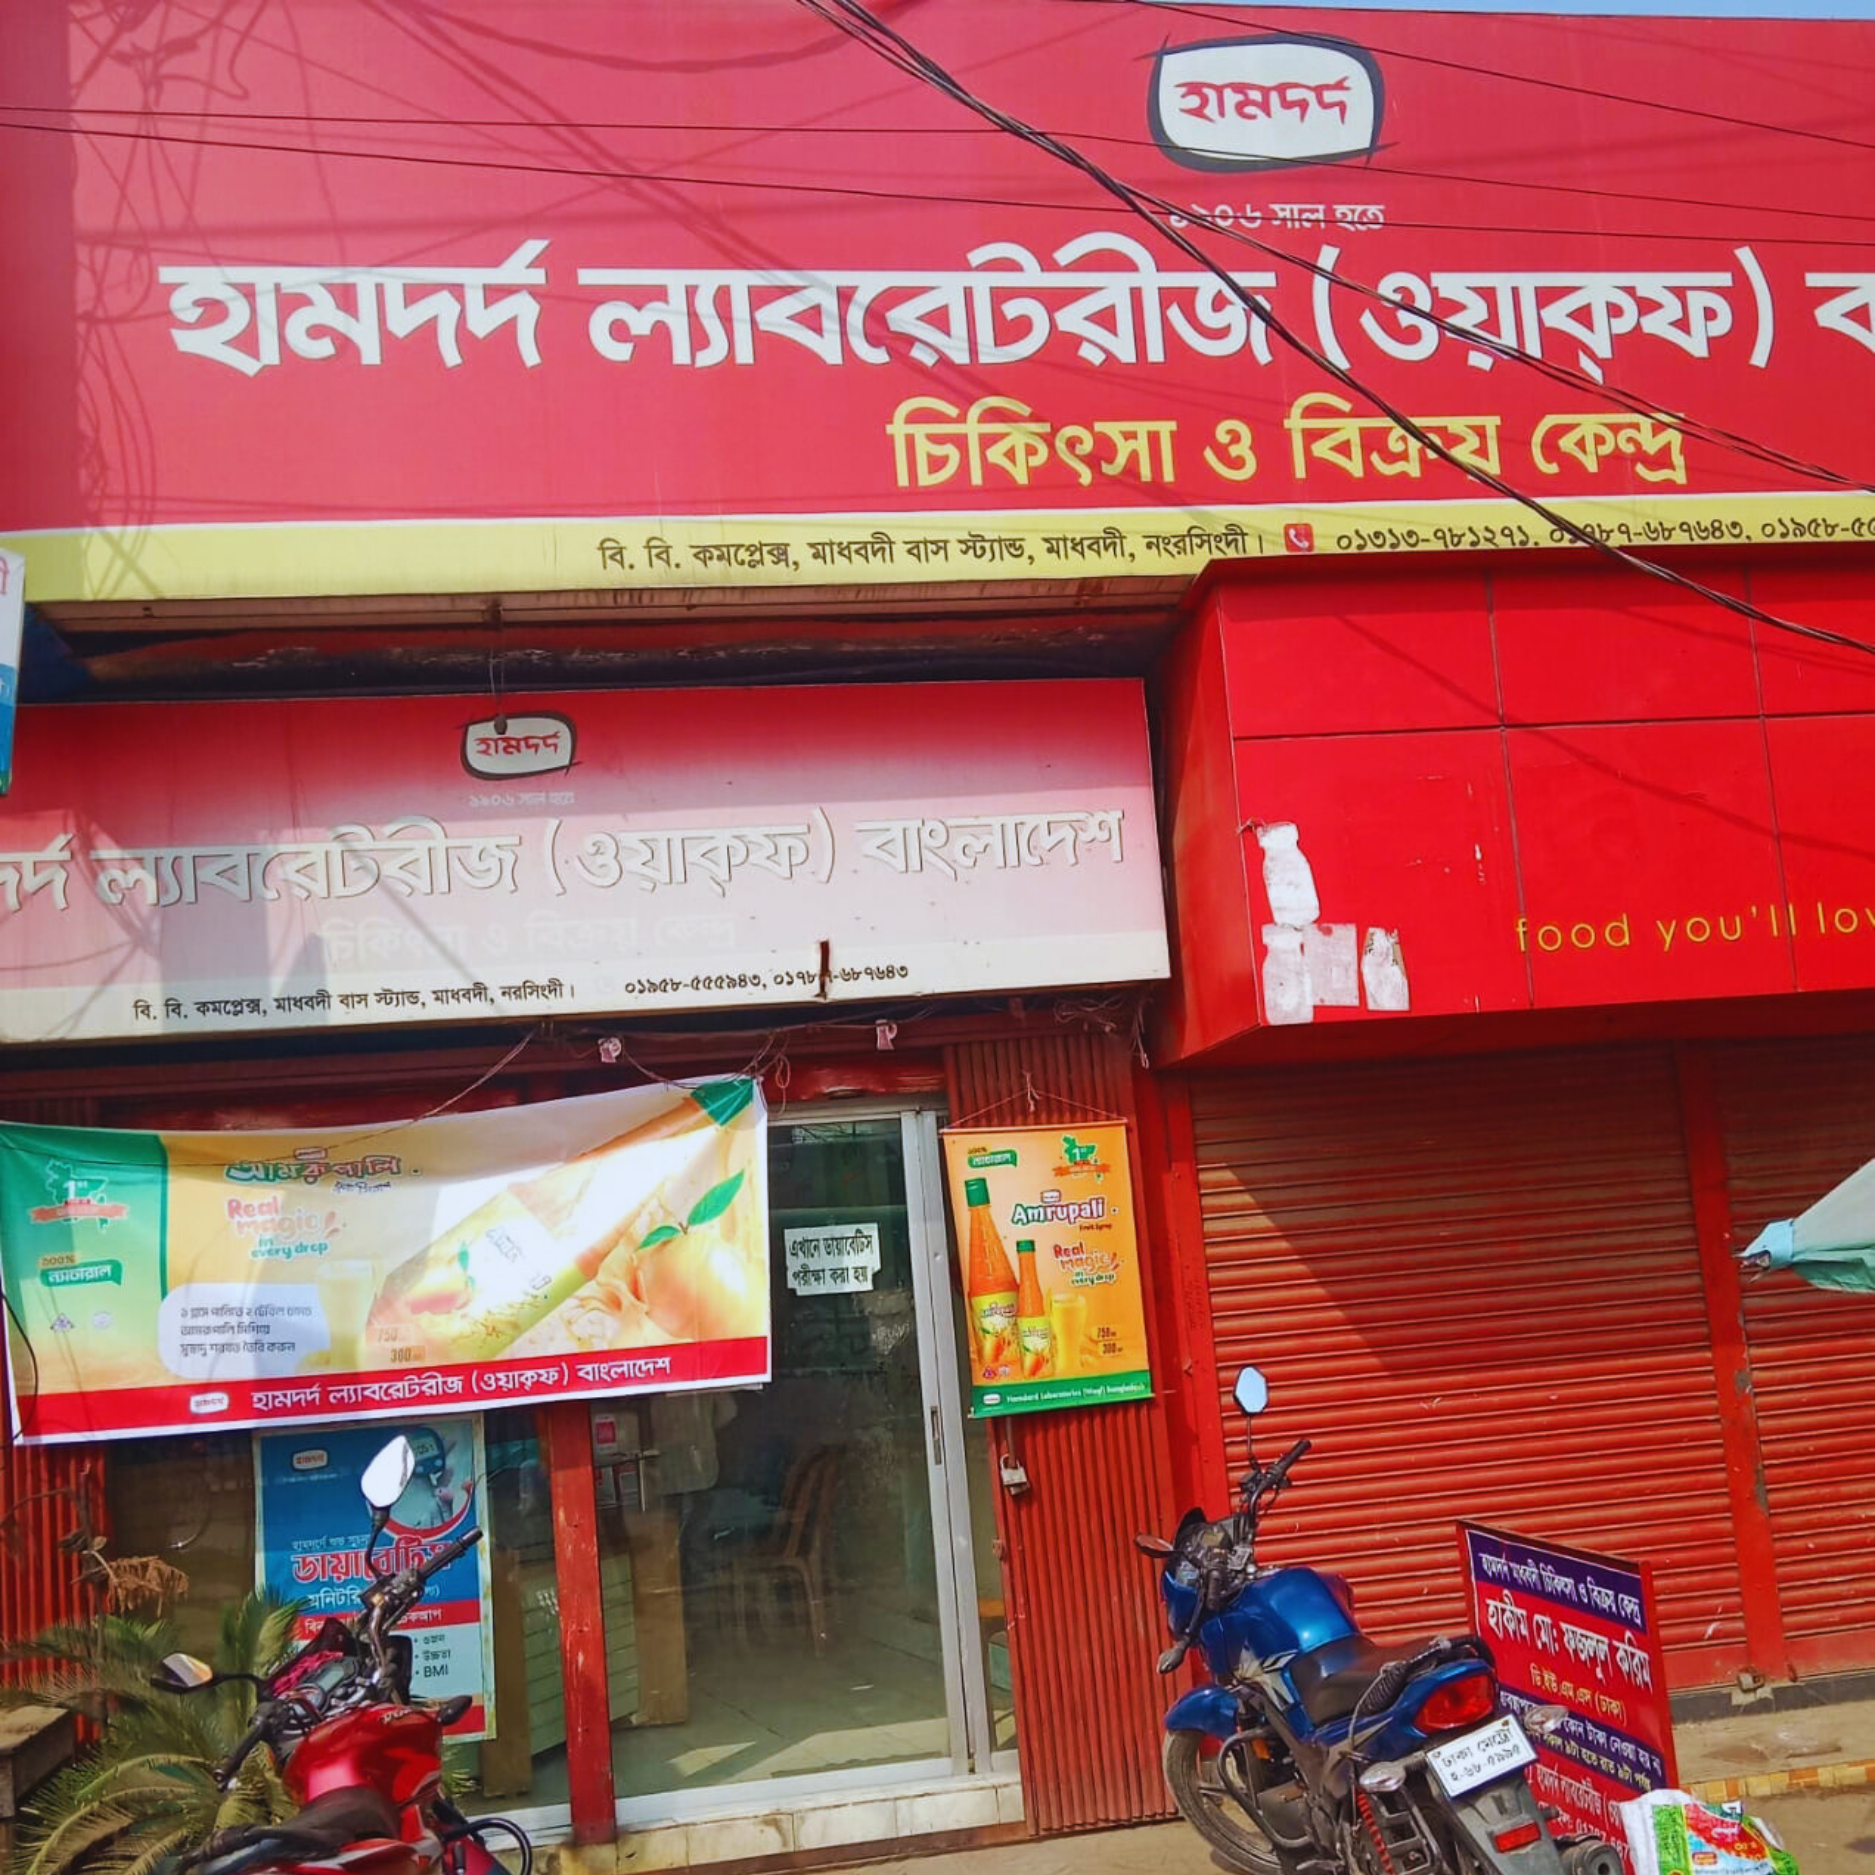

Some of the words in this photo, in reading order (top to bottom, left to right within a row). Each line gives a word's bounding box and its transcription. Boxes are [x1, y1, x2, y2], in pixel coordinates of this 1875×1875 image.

[1175, 76, 1352, 124] হামদর্দ
[1269, 203, 1326, 230] সাল
[1333, 204, 1386, 232] হতে
[158, 239, 552, 378] হামদর্দ
[578, 231, 1276, 368] ল্যাবরেটরীজ
[886, 395, 1177, 489] চিকিৎসা
[1203, 418, 1257, 481] ও
[1284, 392, 1502, 484] বিক্রয়
[1532, 410, 1690, 486] কেন্দ্র
[597, 537, 635, 570] বি.
[643, 536, 681, 569] বি.
[689, 540, 801, 572] কমপ্লেক্স,
[807, 531, 896, 566] মাধবদী
[903, 537, 950, 564] বাস
[957, 531, 1036, 566] স্ট্যান্ড,
[1041, 527, 1137, 563] মাধবদী,
[471, 730, 562, 756] হামদর্দ
[90, 815, 523, 910] ল্যাবরেটরীজ
[854, 808, 1126, 882] বাংলাদেশ
[1515, 912, 1632, 953] food
[1655, 902, 1799, 952] you'll
[133, 998, 157, 1021] বি.
[164, 997, 188, 1020] বি.
[193, 996, 268, 1018] কমপ্লেক্স,
[273, 989, 332, 1014] মাধবদী
[338, 992, 369, 1010] বাস
[374, 986, 426, 1010] স্ট্যান্ড,
[431, 981, 495, 1006] মাধবদী,
[227, 1196, 280, 1219] Real
[1012, 1196, 1105, 1225] Amrupali
[1053, 1240, 1085, 1259] Real
[251, 1382, 321, 1411] হামদর্দ
[328, 1371, 464, 1405] ল্যাবরেটরীজ
[576, 1356, 672, 1383] বাংলাদেশ
[1485, 1588, 1531, 1648] হাকীম
[1612, 1628, 1653, 1696] করিম
[424, 1663, 449, 1679] BMI
